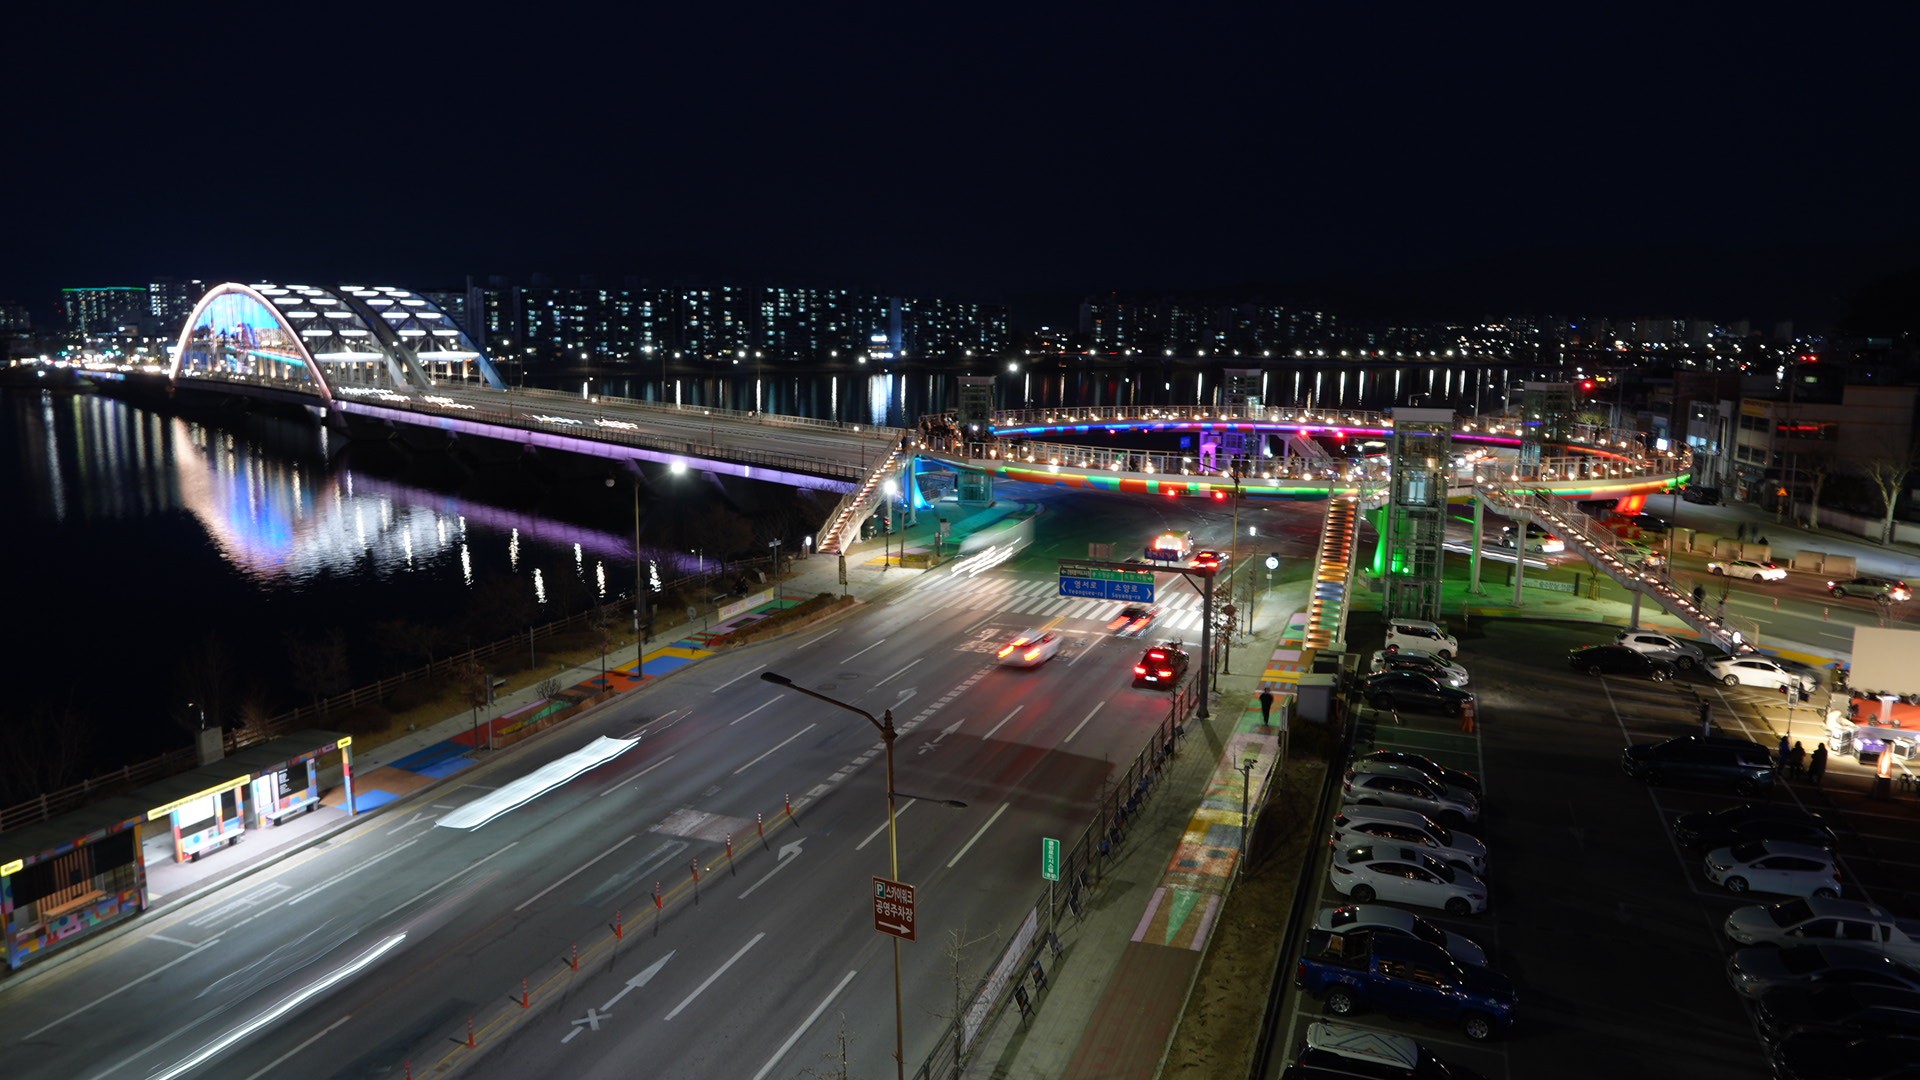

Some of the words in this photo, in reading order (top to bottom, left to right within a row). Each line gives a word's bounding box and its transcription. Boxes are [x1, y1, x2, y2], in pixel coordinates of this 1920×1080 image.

[1074, 581, 1097, 590] 영서로
[1114, 585, 1138, 593] 소양로
[876, 883, 883, 896] P
[886, 885, 913, 905] 스카이워크
[875, 899, 914, 923] 공영주차장
